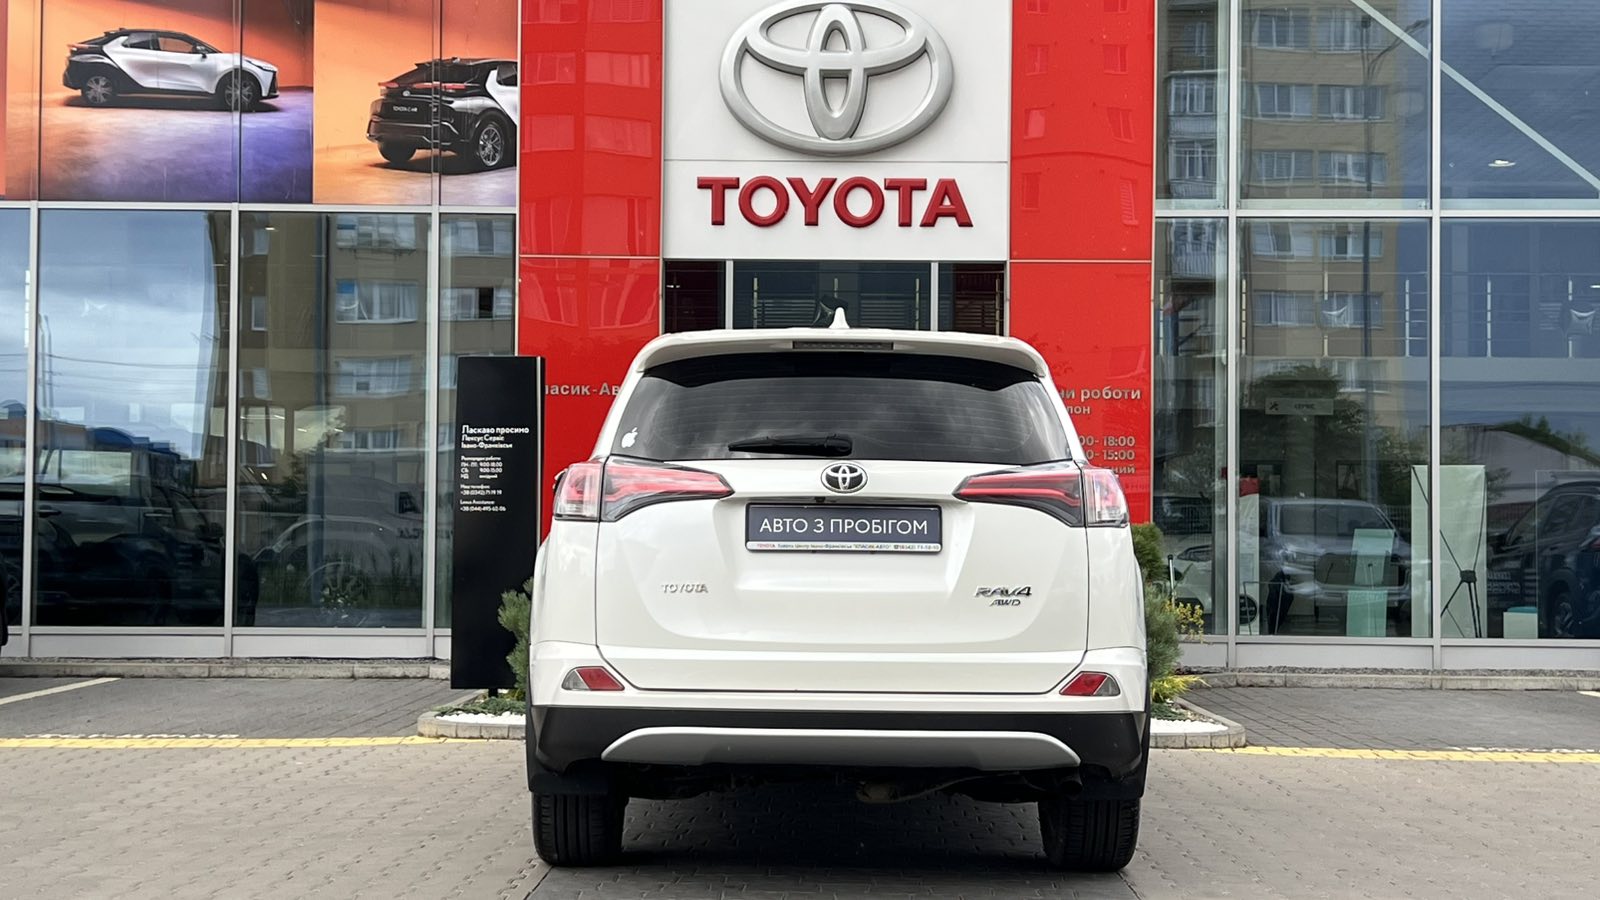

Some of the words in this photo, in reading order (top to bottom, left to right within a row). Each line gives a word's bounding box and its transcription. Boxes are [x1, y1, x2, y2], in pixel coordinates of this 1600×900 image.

[697, 175, 974, 229] TOYOTA
[1080, 386, 1142, 403] роботи
[495, 427, 530, 436] просимо
[1103, 436, 1136, 447] 18:00
[1102, 449, 1136, 461] 15:00
[759, 518, 809, 533] АВТО
[830, 518, 929, 536] ПРОБІГОМ
[661, 583, 708, 594] TOYOTA
[975, 586, 1033, 597] RAV4
[990, 598, 1021, 607] AWD
